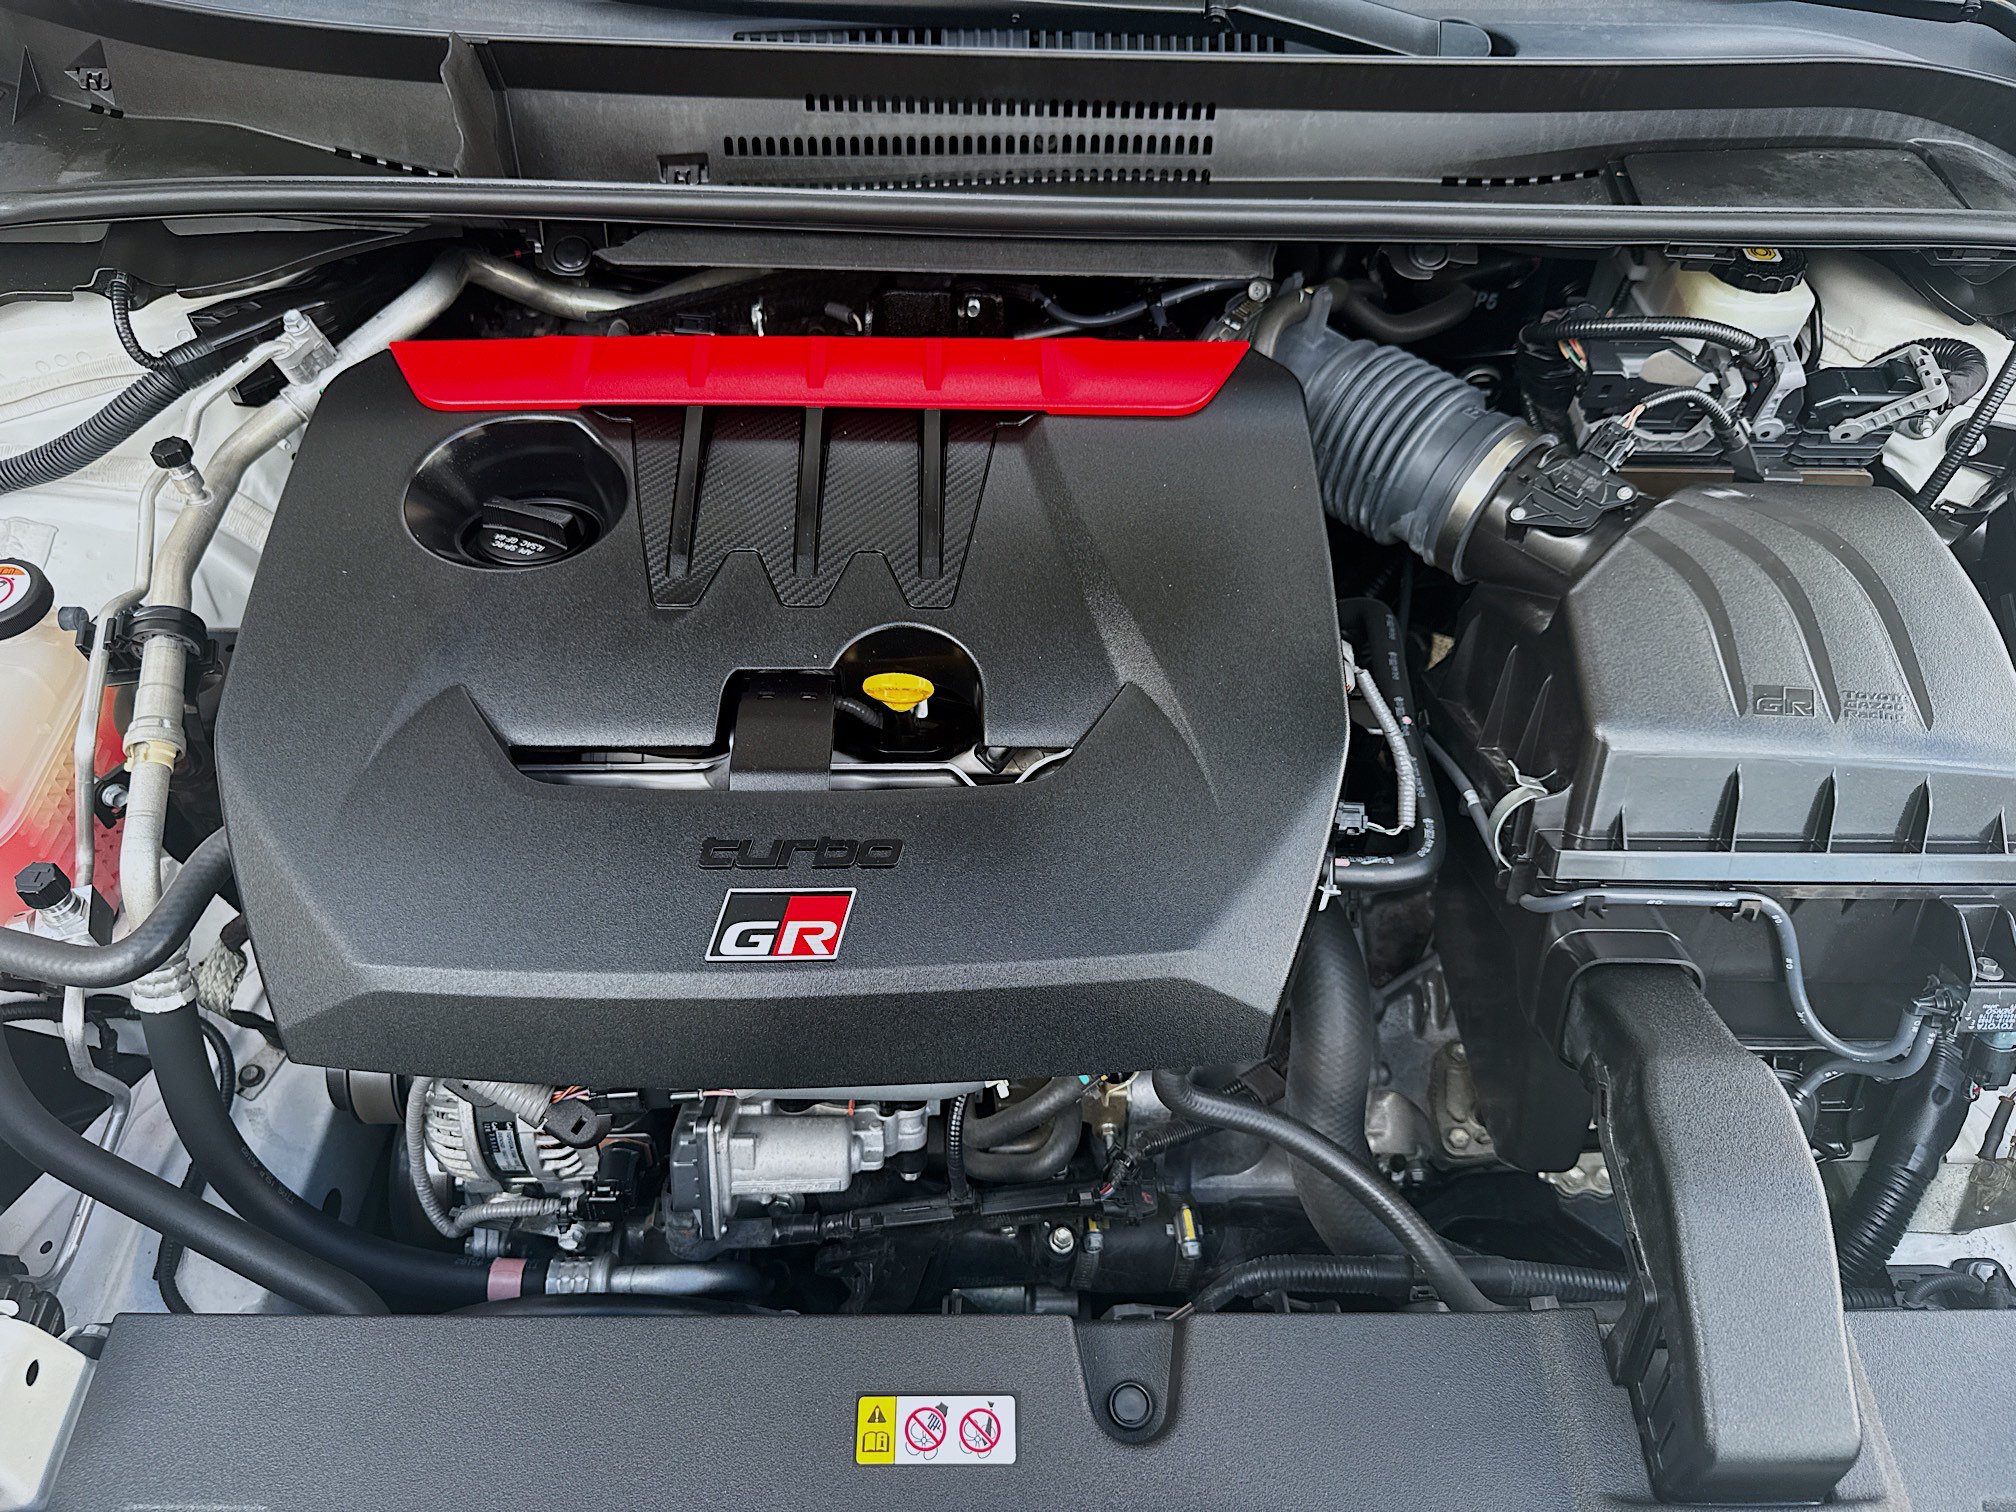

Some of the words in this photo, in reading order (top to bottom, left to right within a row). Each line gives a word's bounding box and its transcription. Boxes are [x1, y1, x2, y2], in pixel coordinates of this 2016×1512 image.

[518, 547, 535, 556] API
[519, 540, 546, 553] ILSAC
[698, 836, 905, 870] turbo
[718, 920, 839, 956] GR
[1977, 1022, 2014, 1030] TOYOTA
